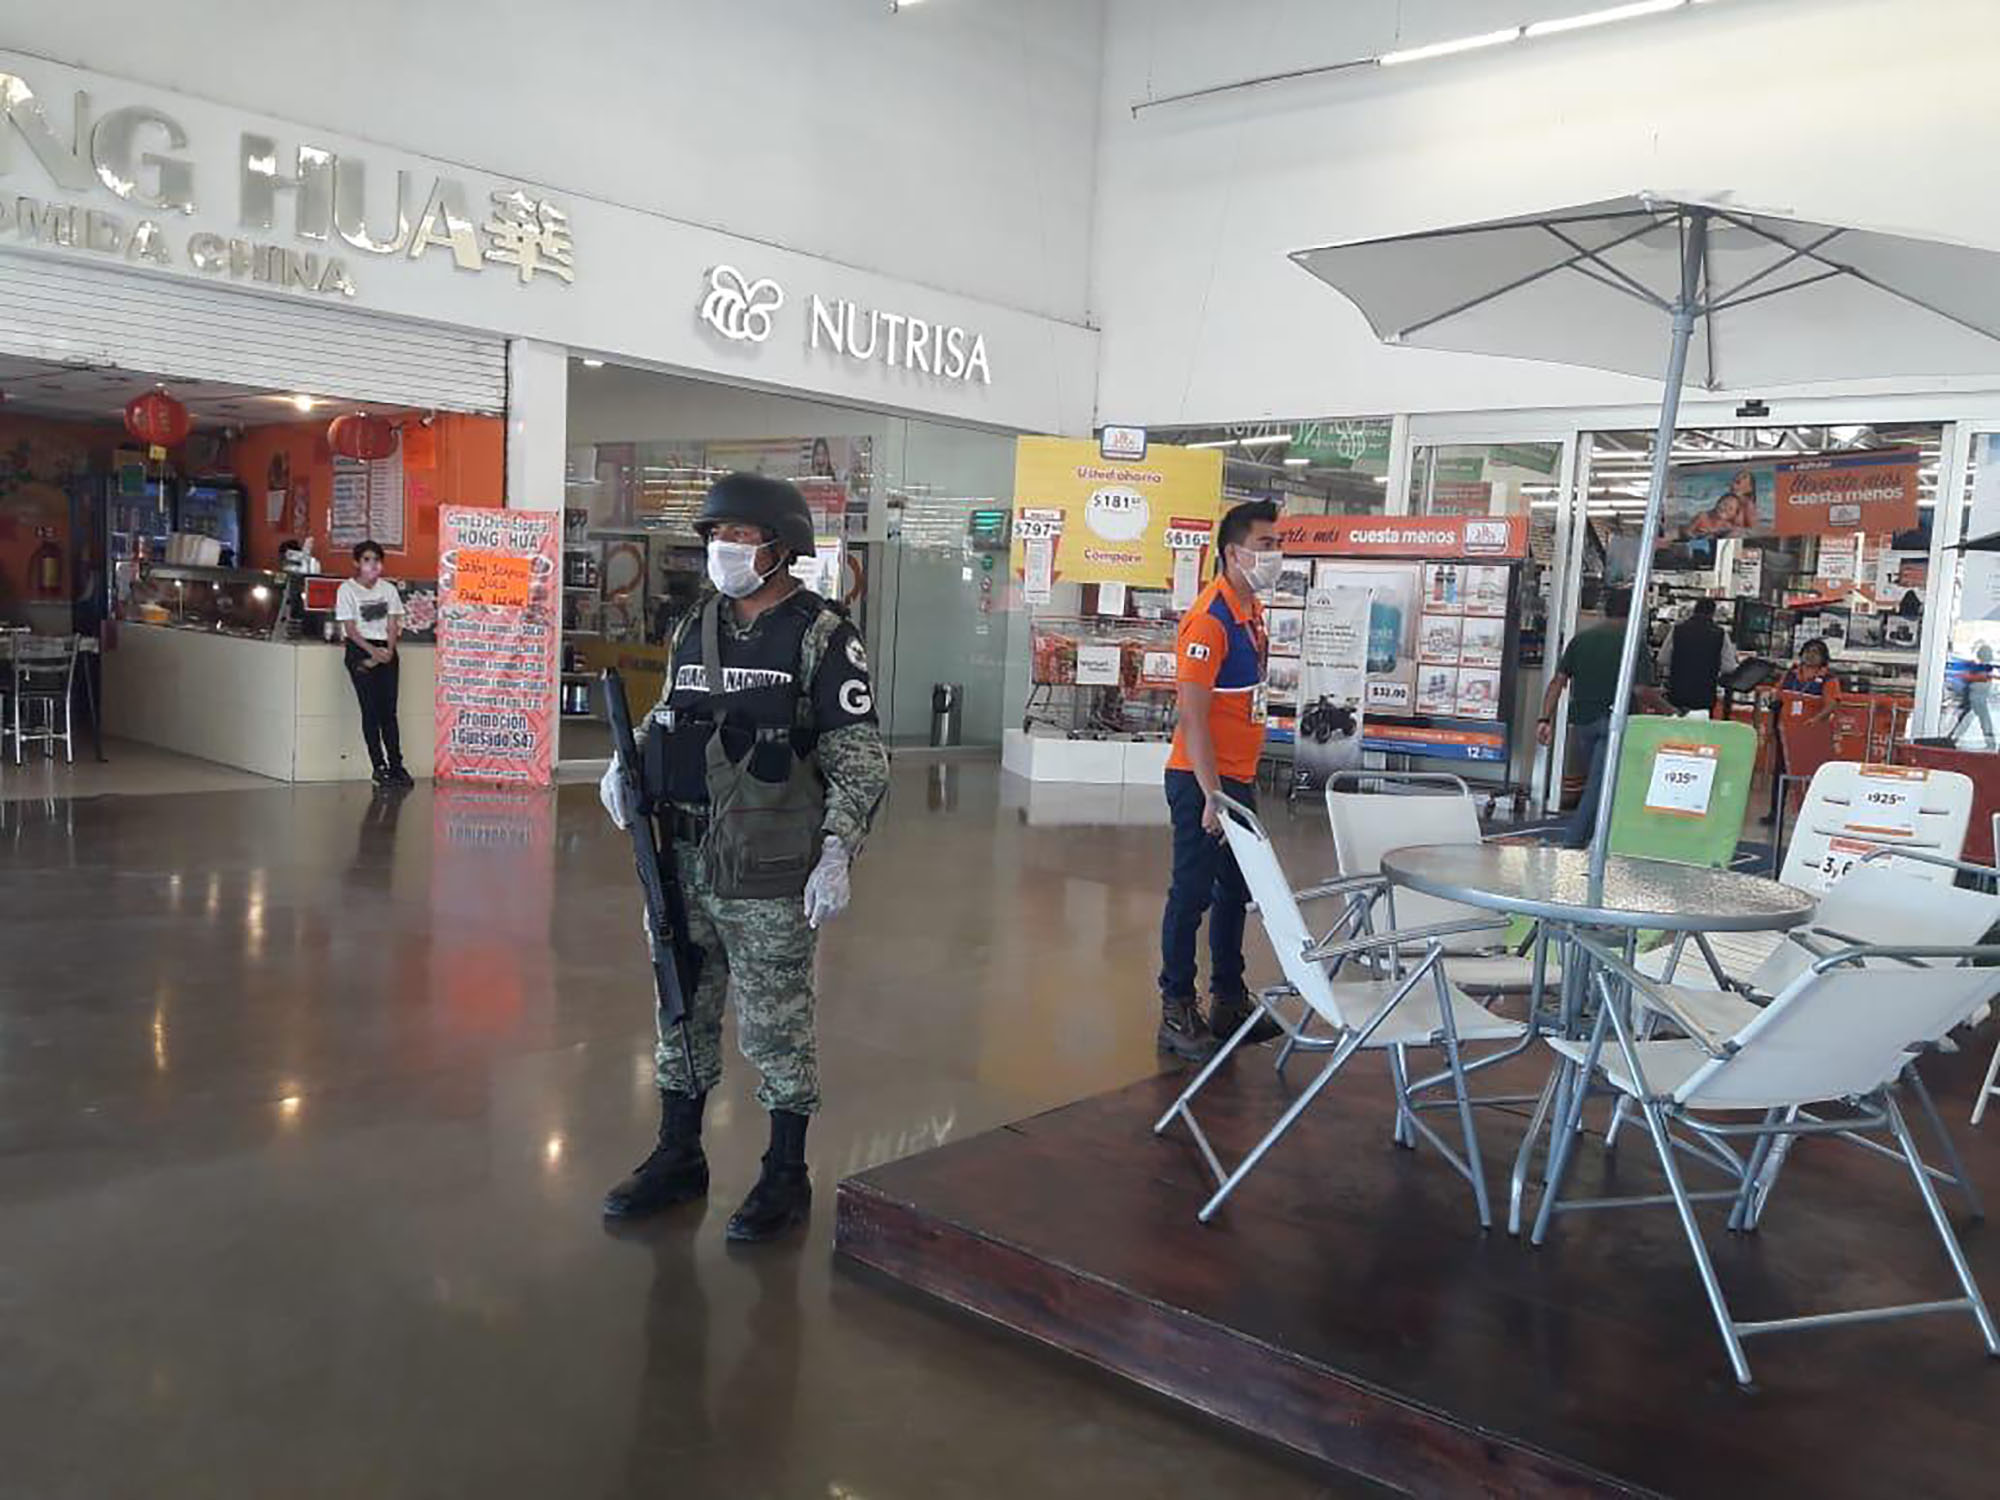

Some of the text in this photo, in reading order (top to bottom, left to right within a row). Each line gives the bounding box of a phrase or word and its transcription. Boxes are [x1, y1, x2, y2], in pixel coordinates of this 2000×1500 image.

[238, 131, 482, 271] HUA
[187, 231, 357, 297] CHINA
[811, 294, 991, 384] NUTRISA
[1077, 466, 1161, 484] Usted ahorra
[1789, 487, 1904, 505] cuesta menos
[457, 530, 538, 549] HONG HUA
[1350, 527, 1398, 544] cuesta
[1400, 527, 1456, 544] menos
[839, 679, 871, 714] G
